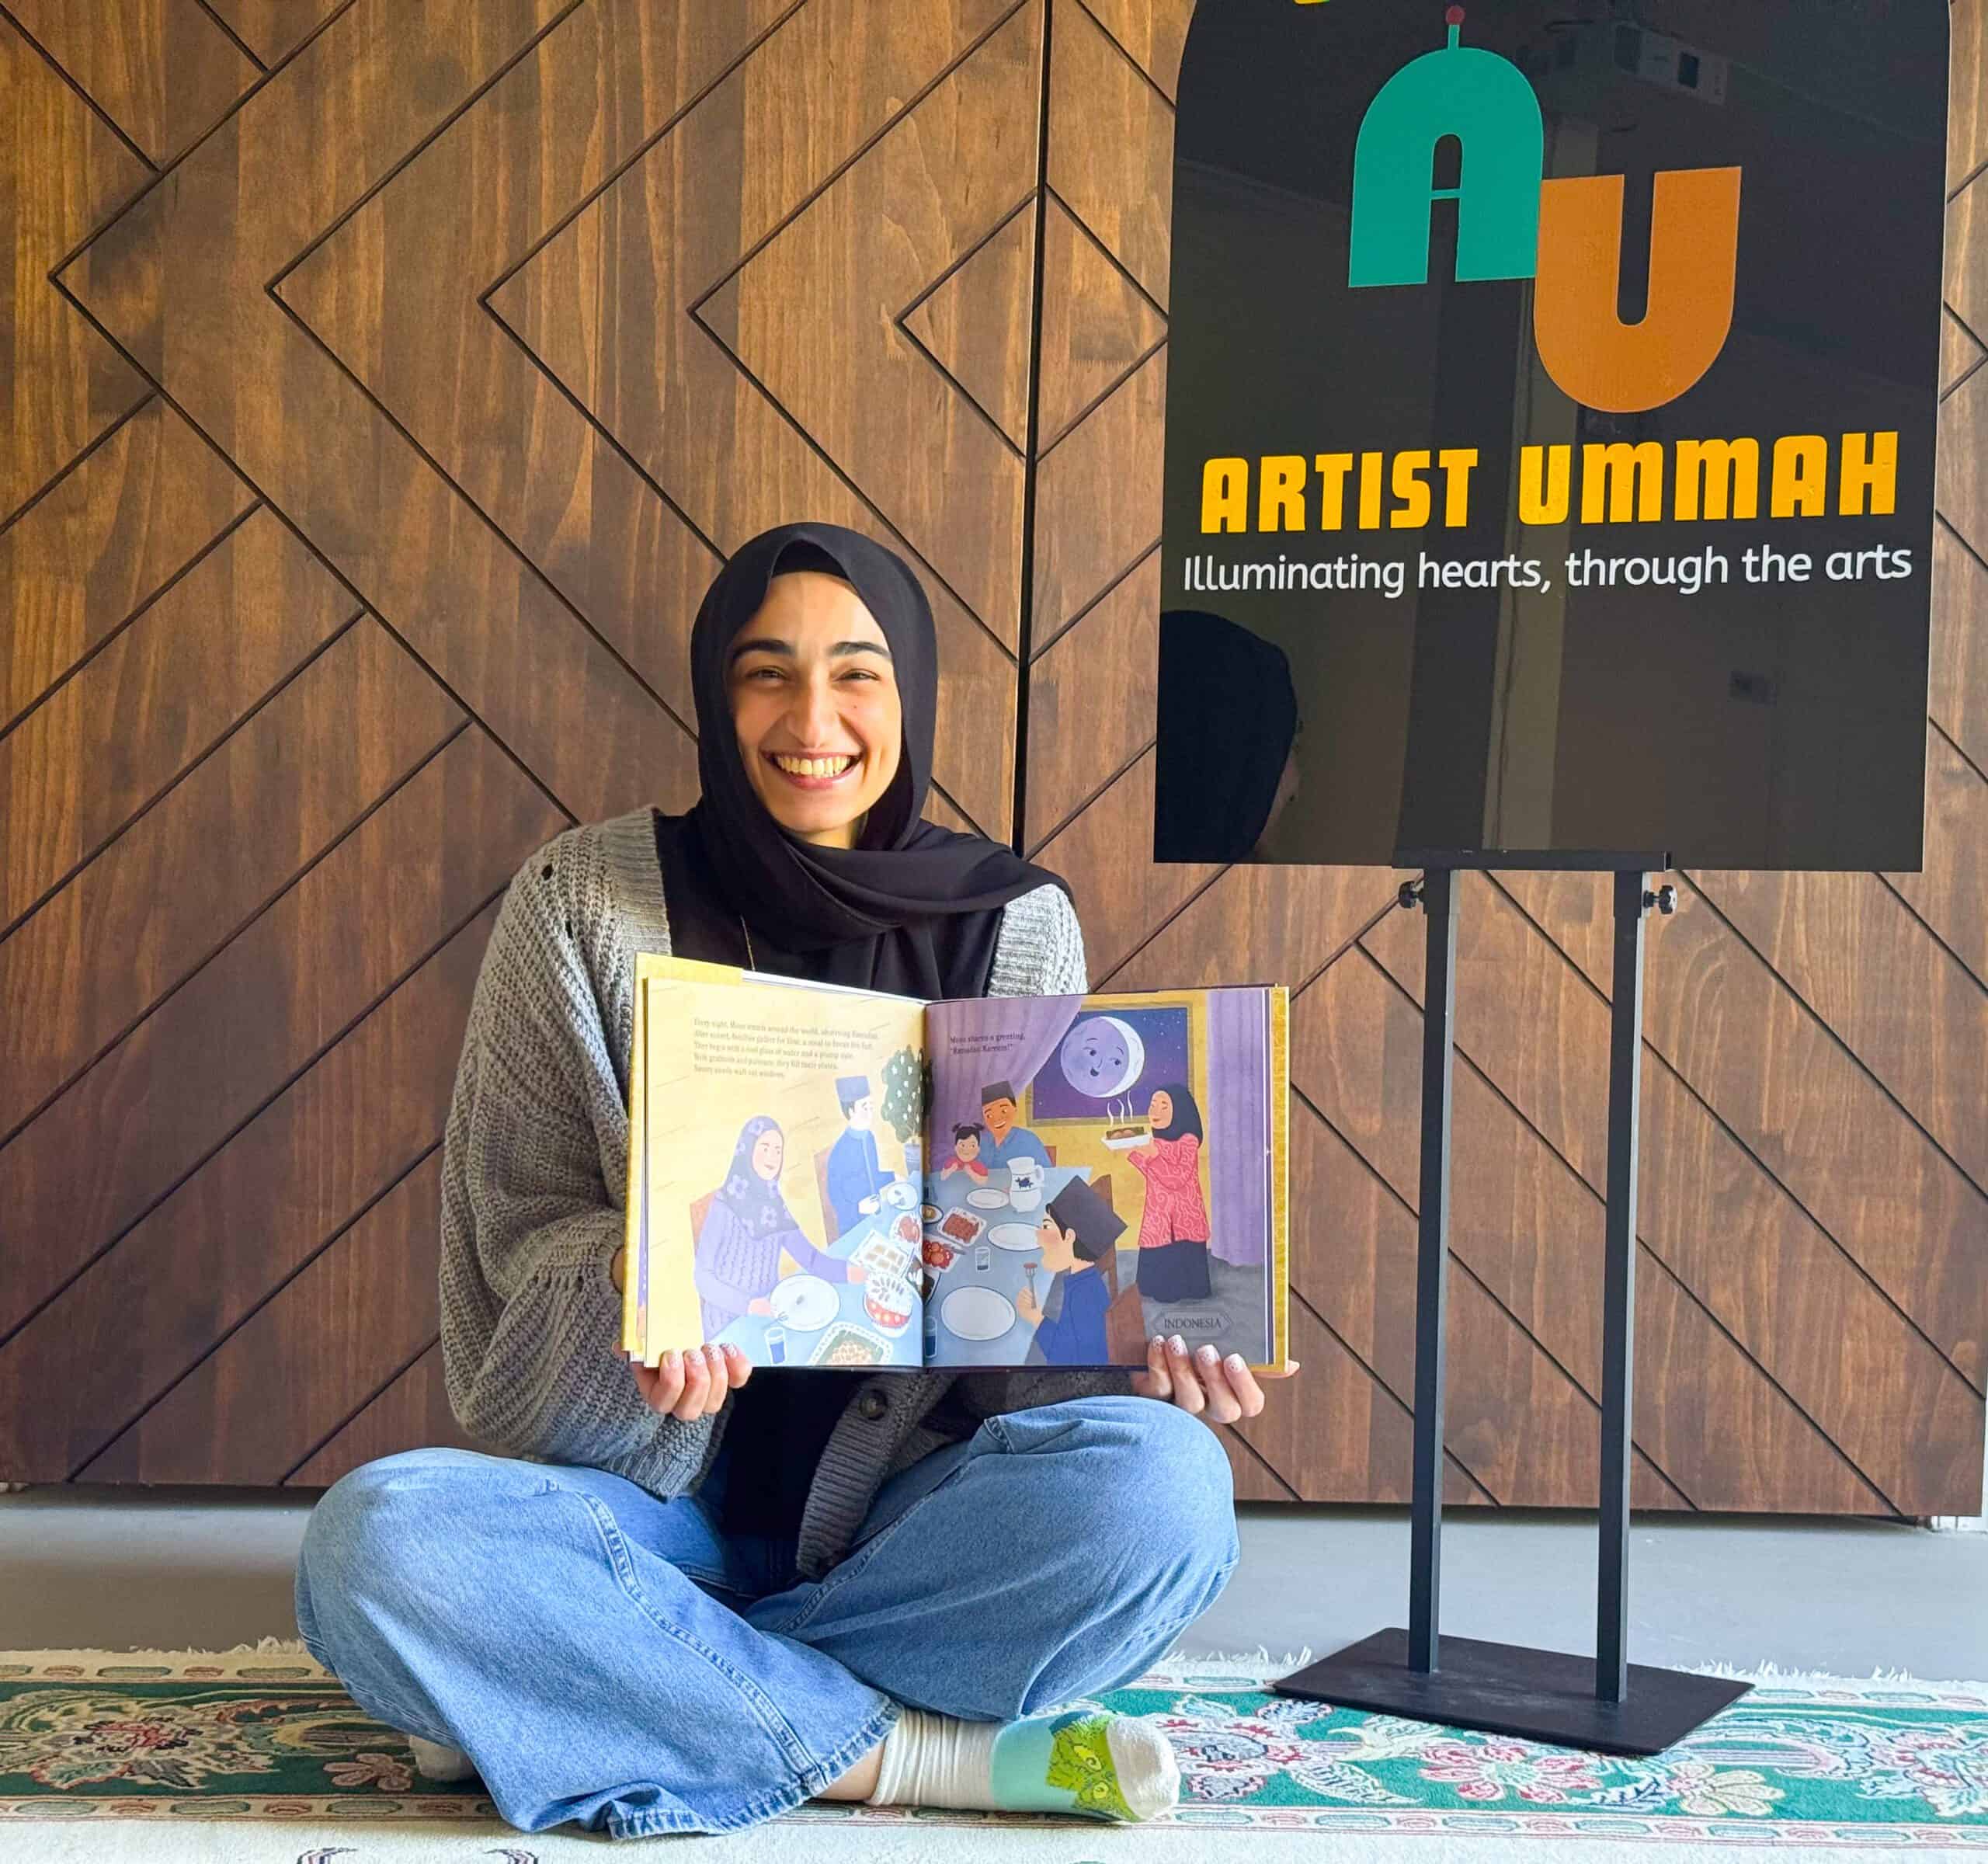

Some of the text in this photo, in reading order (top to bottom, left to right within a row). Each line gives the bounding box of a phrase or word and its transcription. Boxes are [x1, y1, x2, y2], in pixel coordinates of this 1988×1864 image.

[1201, 432, 1897, 533] ARTIST UMMAH
[1185, 544, 1911, 598] Illuminating hearts, through the arts
[1164, 1318, 1222, 1330] INDONESIA
